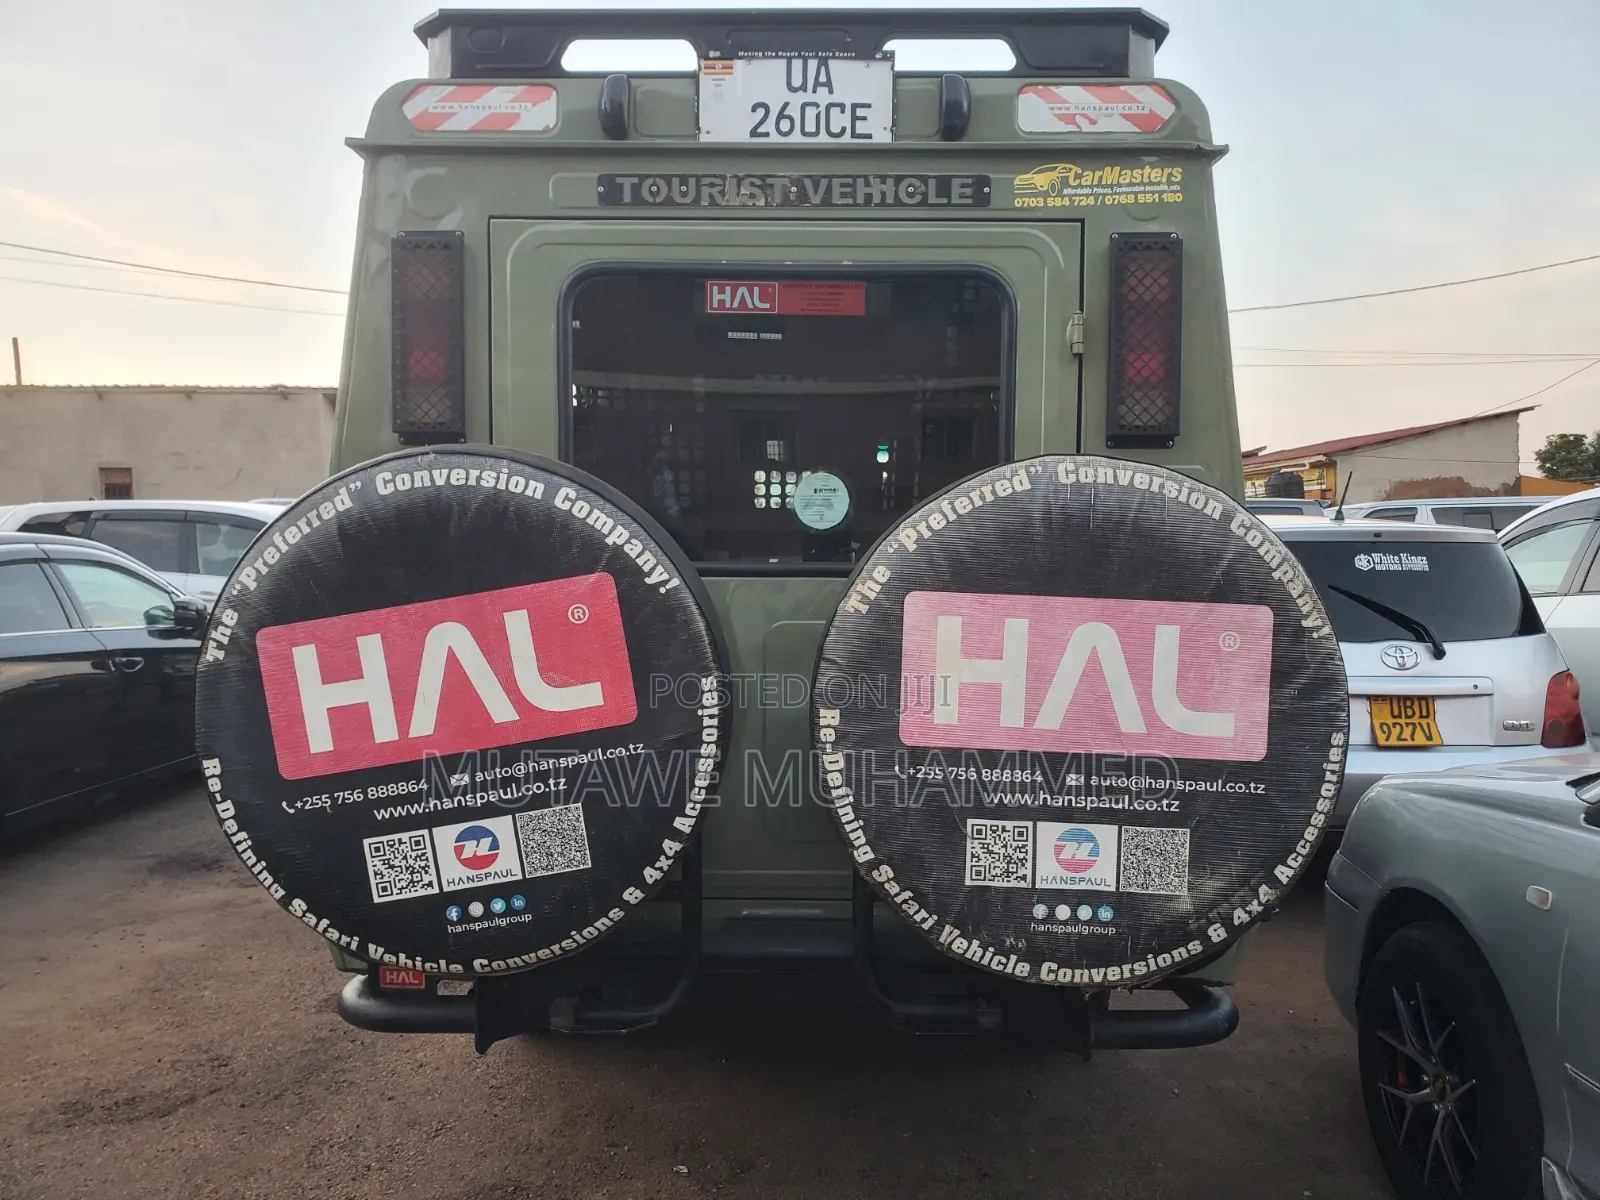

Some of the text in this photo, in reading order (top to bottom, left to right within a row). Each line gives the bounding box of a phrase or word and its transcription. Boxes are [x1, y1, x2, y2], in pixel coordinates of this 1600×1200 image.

[738, 50, 763, 58] Making
[786, 58, 834, 94] UA
[1048, 104, 1146, 113] www.hanspaul.co.tz
[749, 101, 873, 140] 260CE
[1068, 165, 1183, 186] CarMasters
[615, 176, 974, 205] TOURIST VEHICLE
[1014, 197, 1044, 208] 0703
[1047, 197, 1070, 207] 584
[1072, 196, 1095, 206] 724
[1104, 194, 1135, 205] 0768
[1137, 193, 1159, 203] 551
[1162, 192, 1183, 203] 180
[1062, 186, 1093, 195] Affordable
[1112, 185, 1145, 194] Favourable
[712, 285, 770, 309] HAL
[844, 565, 891, 615] The
[1057, 462, 1224, 521] Conversion
[1229, 512, 1331, 639] Company!
[1371, 552, 1428, 566] White Kingz
[206, 608, 239, 662] The
[375, 468, 545, 500] Conversion
[554, 486, 681, 594] Company!
[1374, 563, 1402, 571] MOTORS
[292, 609, 605, 753] HAL
[933, 615, 1236, 737] HAL
[1389, 696, 1431, 719] UBD
[1379, 722, 1434, 742] 927V
[474, 742, 645, 782] auto@hanspaul.co.tz
[907, 766, 1044, 784] +255 756 888864
[1090, 773, 1266, 795] auto@hanspaul.co.tz
[294, 779, 429, 811] +255 756 888864
[373, 777, 567, 821] www.hanspaul.co.tz
[983, 790, 1180, 813] www.hanspaul.co.tz
[202, 675, 719, 975] Re-Defining Safari Vehicle Conversions & 4x4 Accessories
[819, 708, 1344, 984] Re-Defining Safari Vehicle Conversions & 4x4 Accessories
[446, 868, 518, 888] HANSPAUL
[1040, 875, 1112, 887] HANSPAUL
[447, 913, 533, 934] hanspaulgroup
[1030, 921, 1116, 936] hanspaulgroup
[385, 970, 420, 984] HAL
